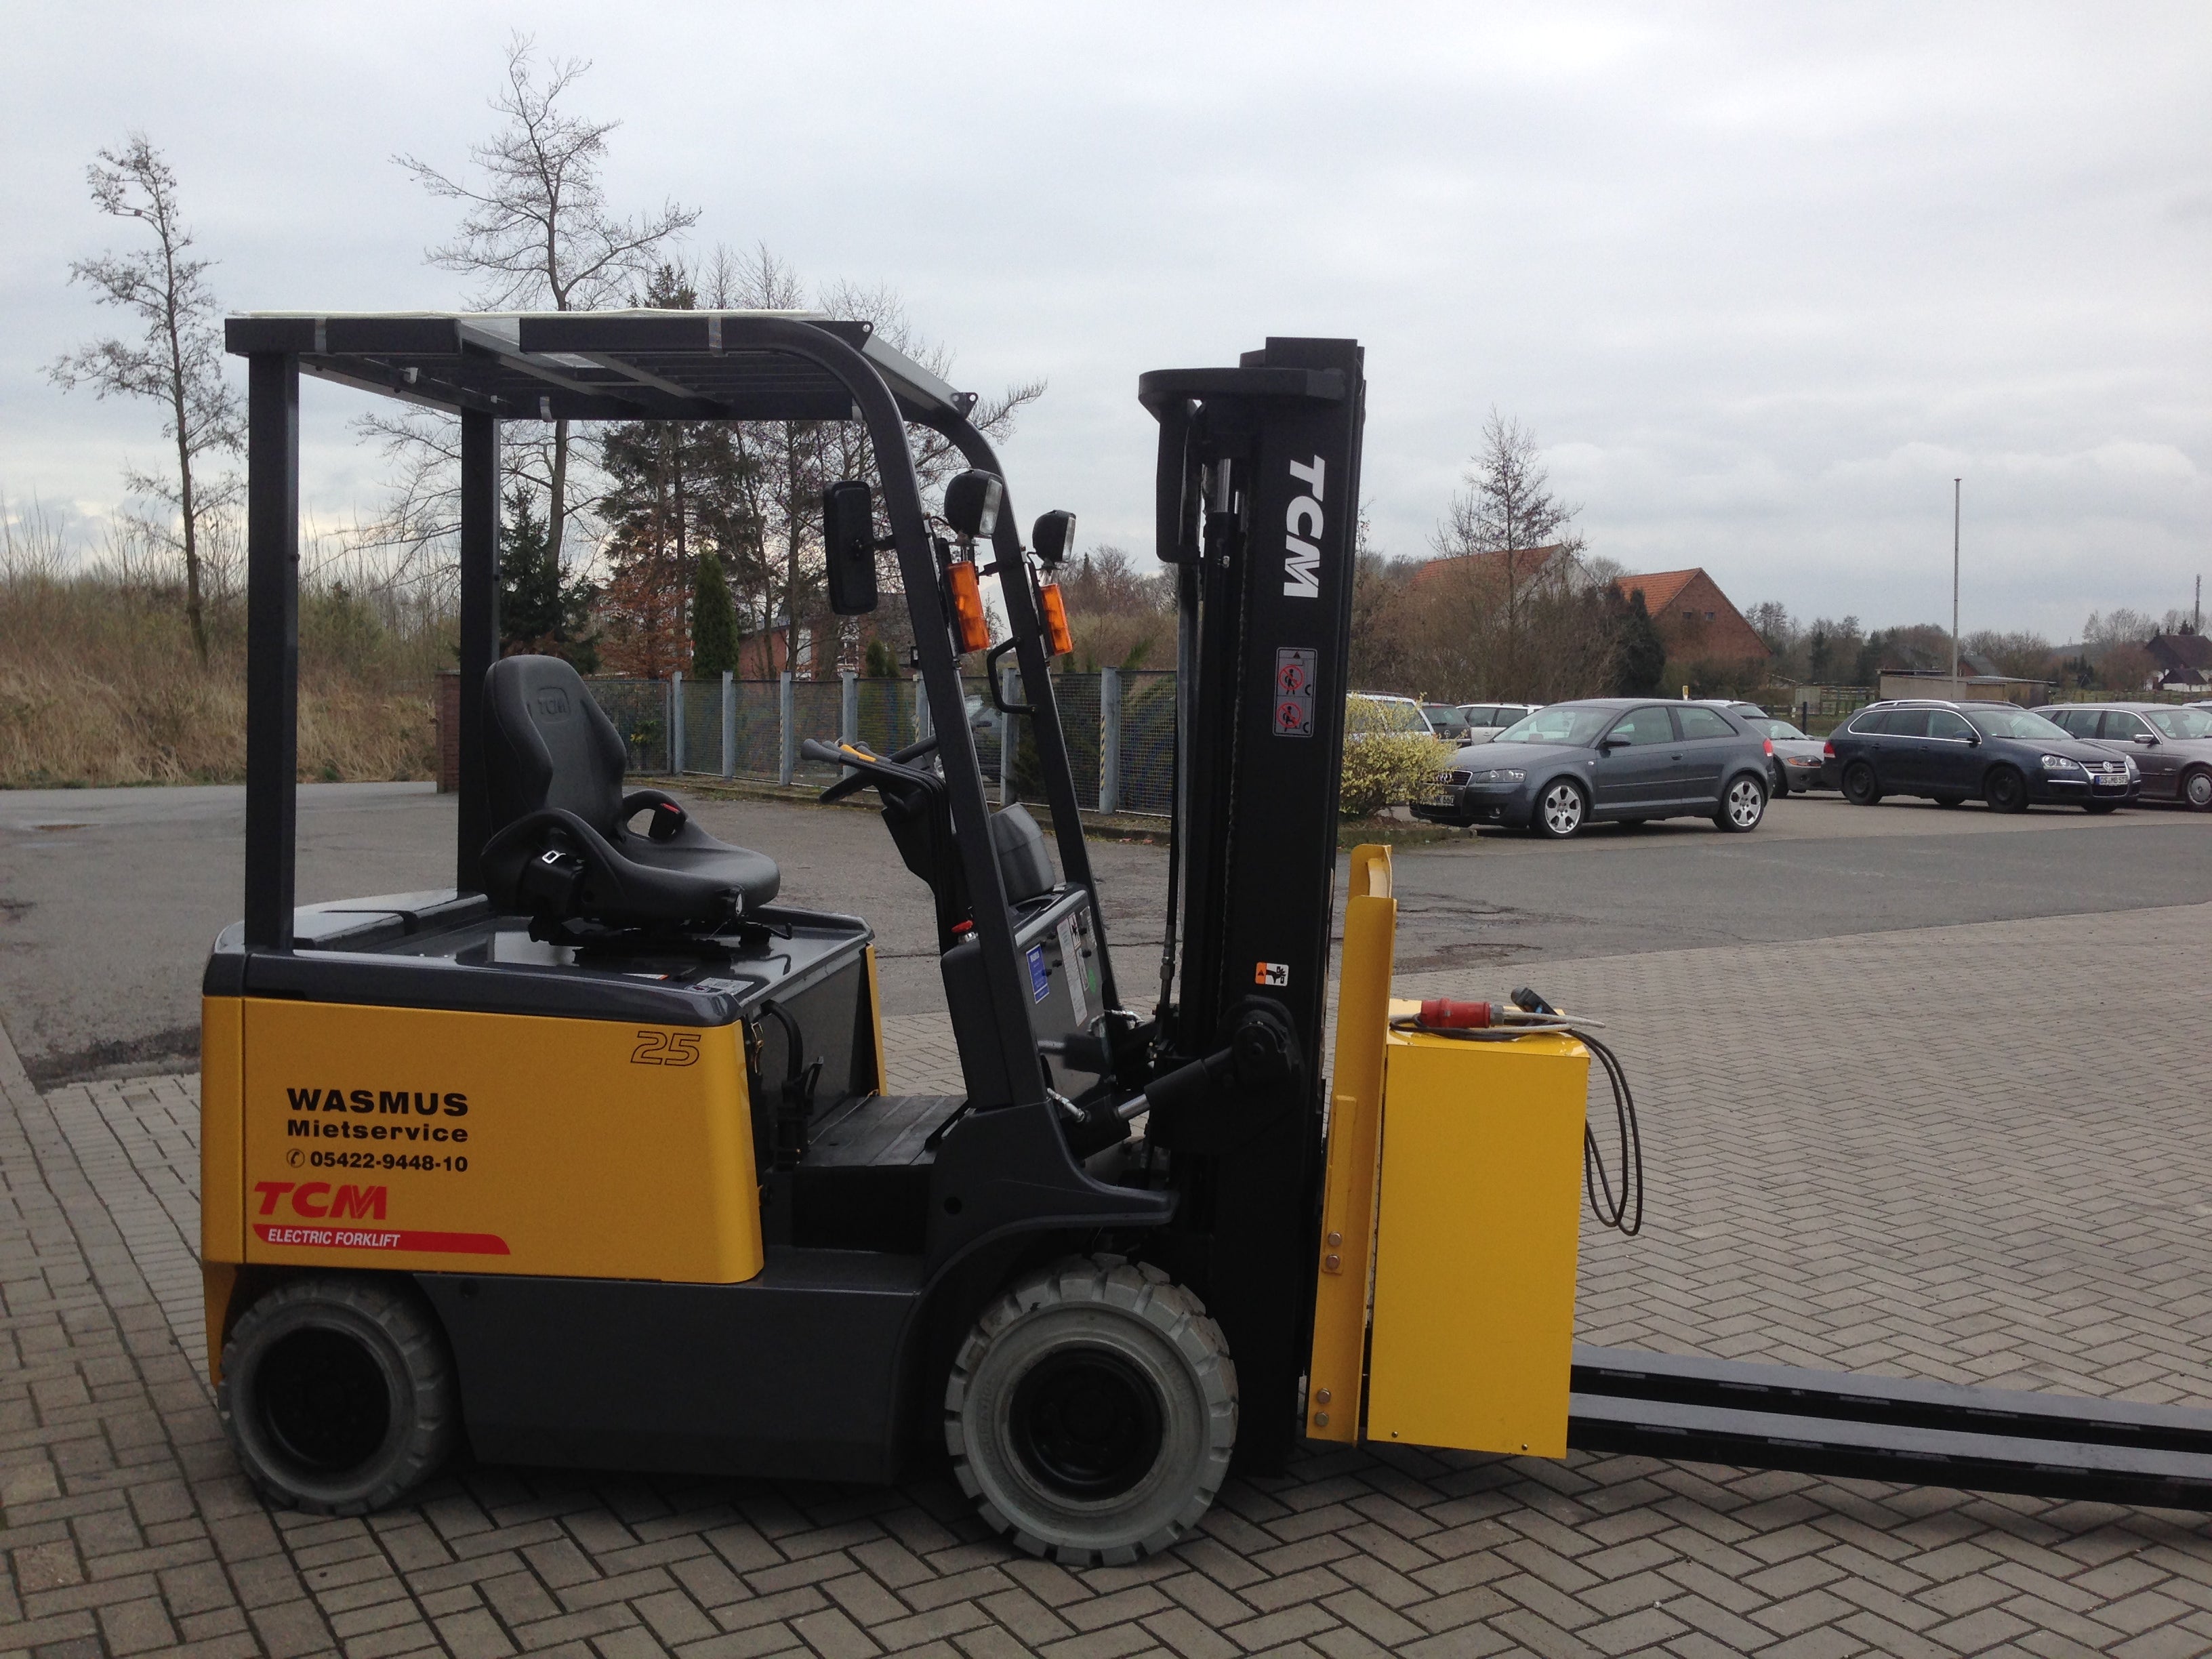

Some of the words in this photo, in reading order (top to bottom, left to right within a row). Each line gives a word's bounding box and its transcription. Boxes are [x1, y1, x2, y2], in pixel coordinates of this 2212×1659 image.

[1283, 454, 1326, 598] TCM
[630, 1031, 701, 1067] 25
[286, 1088, 468, 1117] WASMUS
[287, 1119, 468, 1143] Mietservice
[310, 1151, 468, 1172] 05422-9448-10
[254, 1181, 388, 1220] TCM
[268, 1228, 332, 1244] ELECTRIC
[335, 1231, 401, 1247] FORKLIFT
